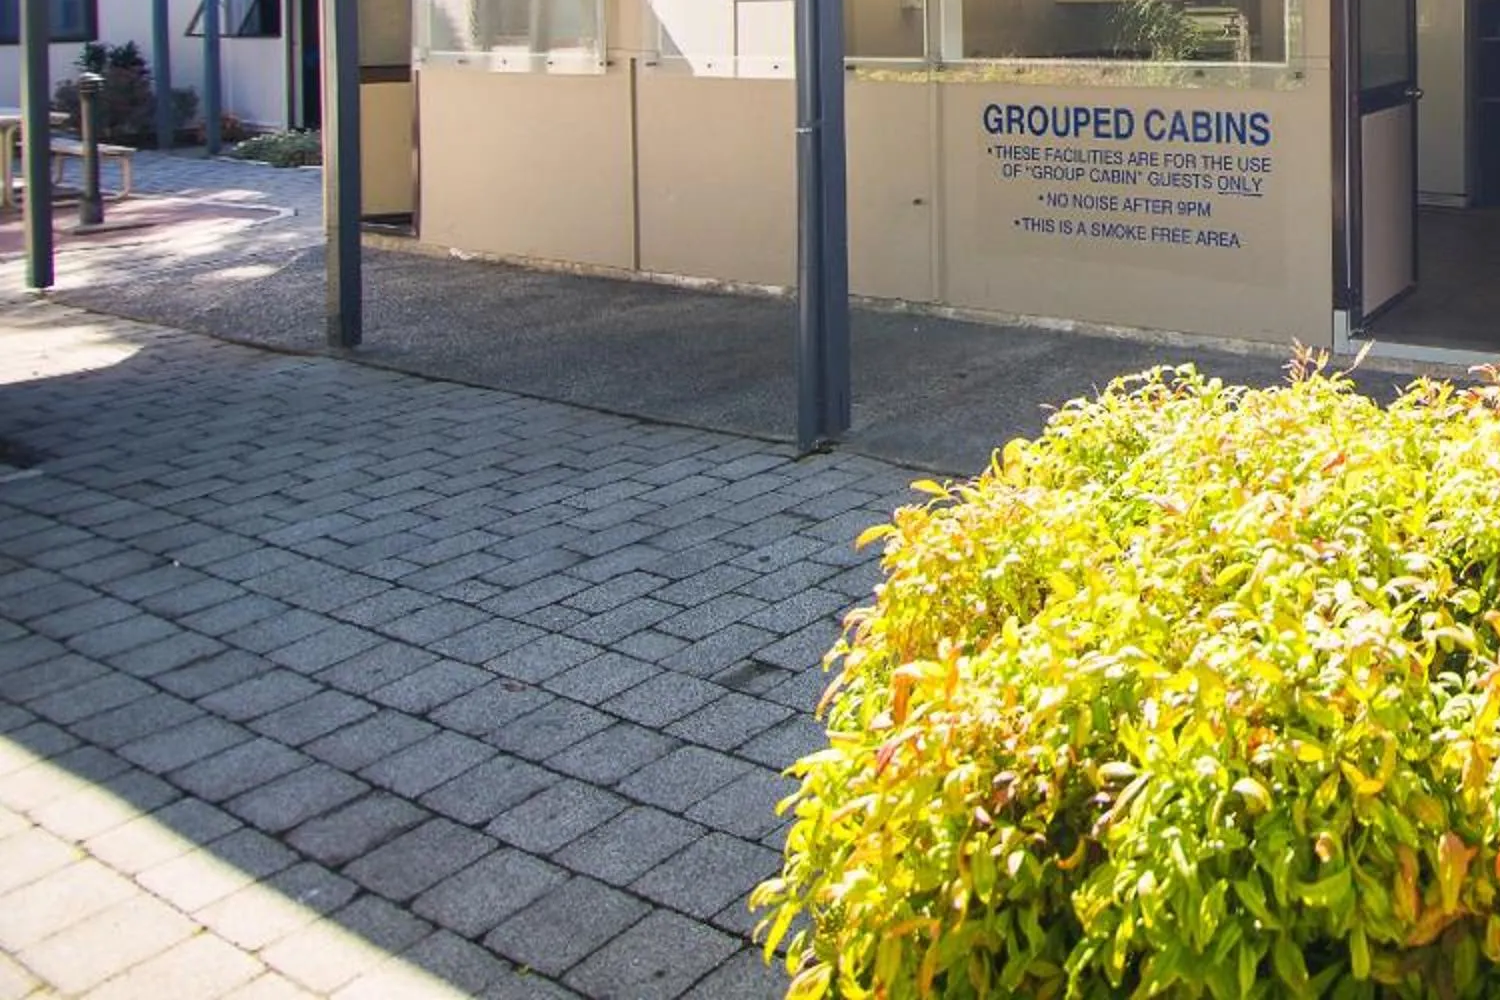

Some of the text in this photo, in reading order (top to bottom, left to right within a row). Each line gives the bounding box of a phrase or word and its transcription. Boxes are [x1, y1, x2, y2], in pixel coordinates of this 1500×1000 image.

[983, 104, 1271, 147] GROUPED CABINS
[994, 145, 1272, 173] THESE FACILITIES ARE FOR THE USE
[1003, 163, 1022, 178] OF
[1147, 171, 1213, 190] GUESTS
[1217, 175, 1263, 192] ONLY
[1046, 192, 1212, 217] NO NOISE AFTER 9PM
[1021, 217, 1241, 249] THIS IS A SMOKE FREE AREA
